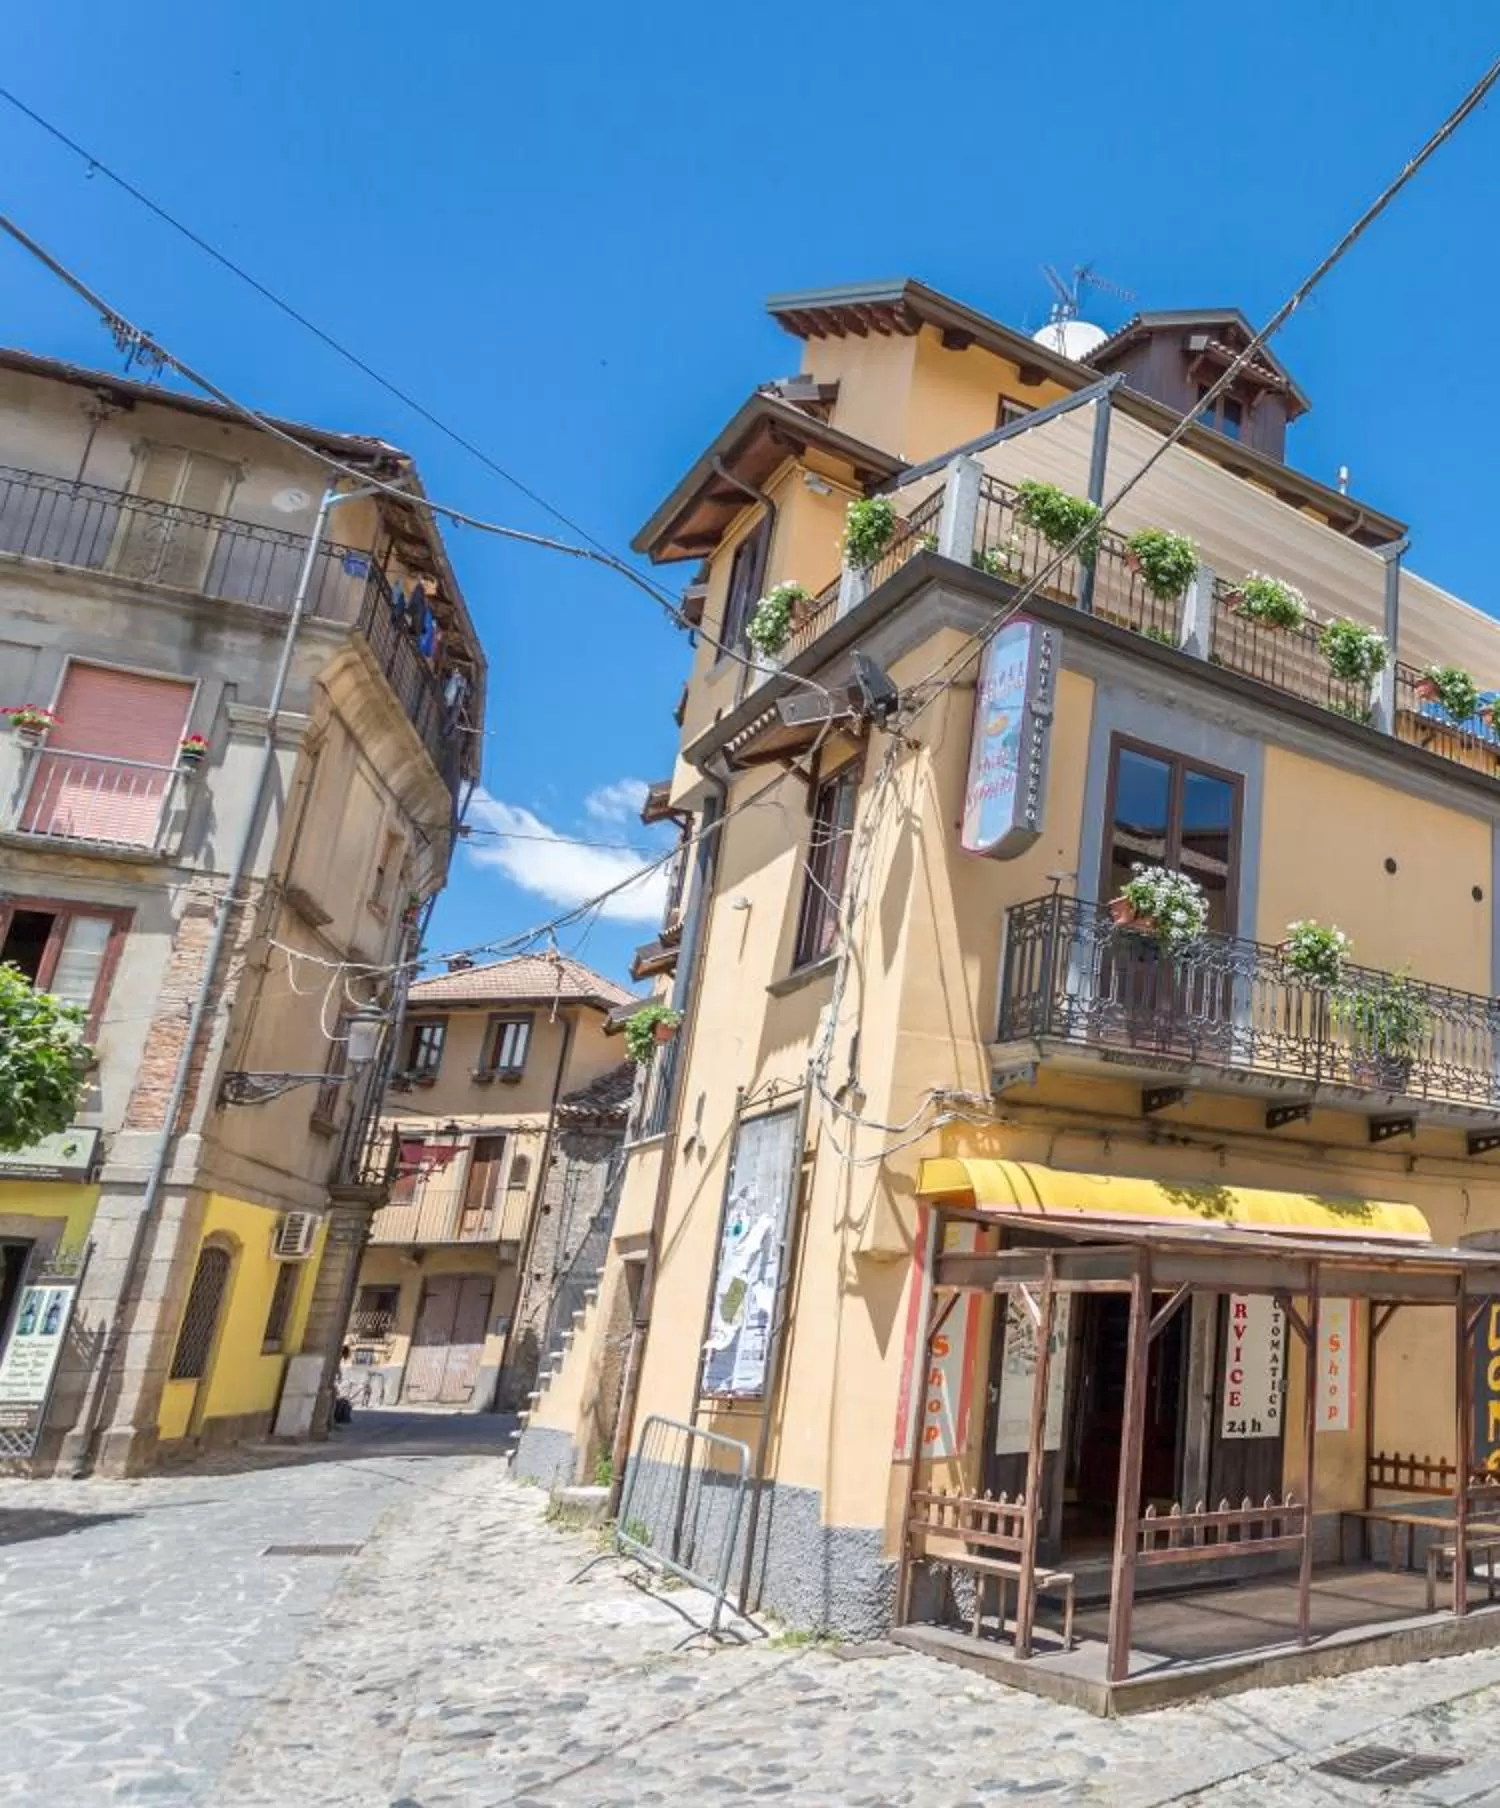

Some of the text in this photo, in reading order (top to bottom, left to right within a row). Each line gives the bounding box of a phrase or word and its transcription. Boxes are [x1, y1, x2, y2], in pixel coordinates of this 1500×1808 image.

[1228, 1303, 1248, 1407] RVICE
[1267, 1297, 1282, 1418] TOMATICO
[1327, 1333, 1341, 1420] Shop
[1226, 1417, 1262, 1434] 24 h
